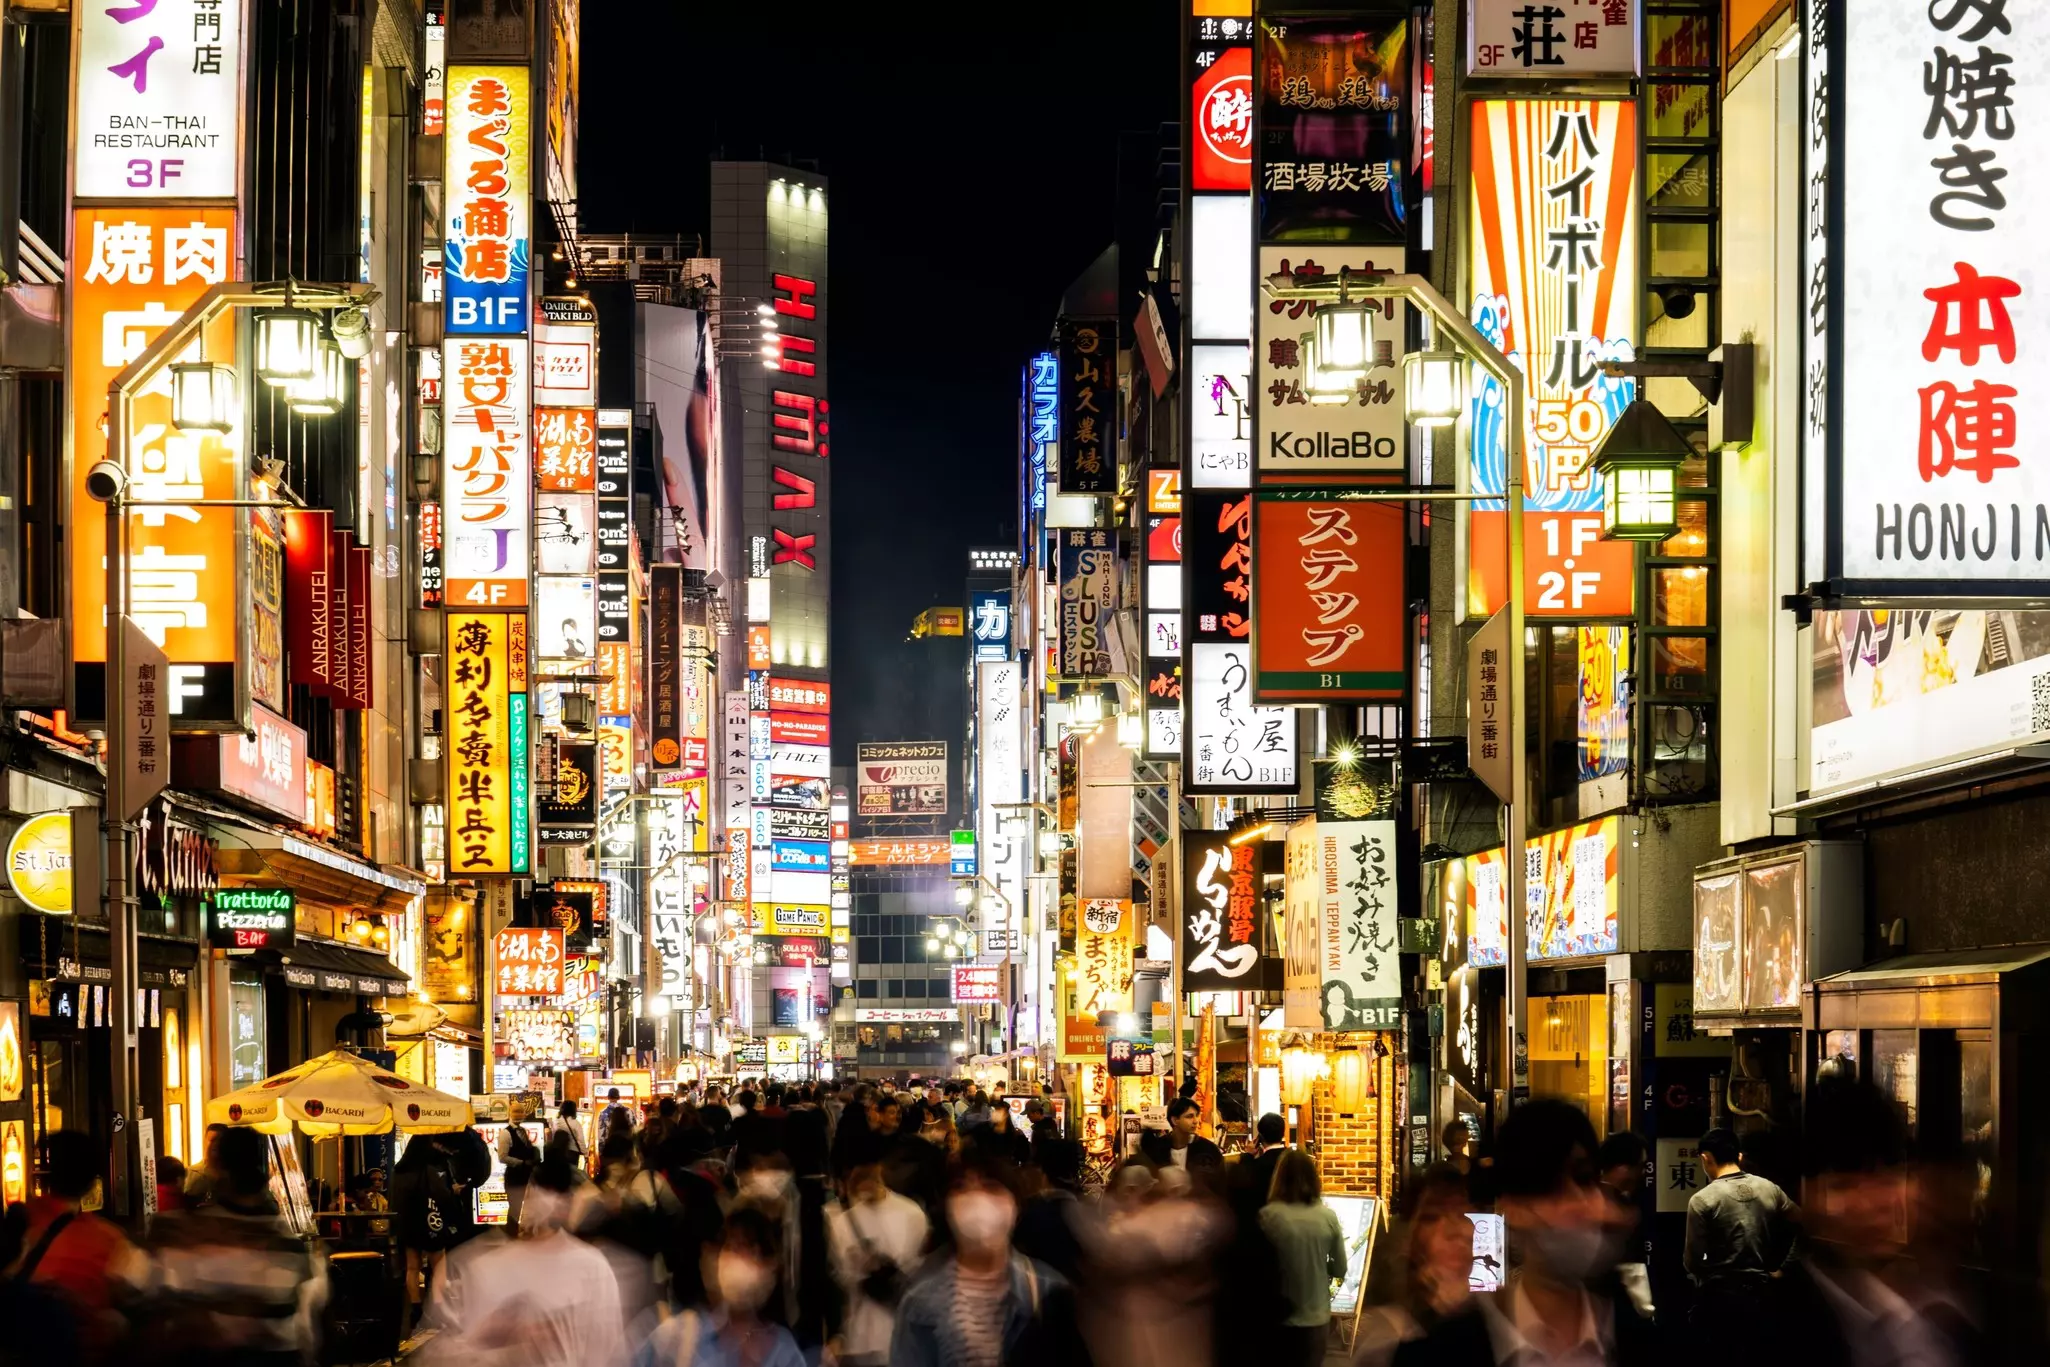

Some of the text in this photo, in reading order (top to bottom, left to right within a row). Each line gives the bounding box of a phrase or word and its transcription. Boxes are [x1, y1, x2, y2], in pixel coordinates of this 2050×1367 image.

[1269, 26, 1288, 39] 2F
[1195, 51, 1215, 67] 4F
[1478, 45, 1505, 66] 3F
[109, 115, 207, 129] BAN-THAI
[94, 134, 219, 148] RESTAURANT
[126, 159, 185, 188] 3F
[463, 78, 511, 281] まぐろ商店
[1264, 161, 1393, 192] 酒場牧場
[84, 221, 228, 285] 焼肉
[1544, 113, 1601, 390] ハイボール
[452, 297, 520, 326] B1F
[544, 302, 582, 312] DAIICHI
[572, 311, 593, 321] BLD
[1917, 261, 2023, 484] 本陣
[1268, 378, 1396, 407] サムサル
[452, 343, 522, 523] 熟女キャバクラ
[538, 412, 593, 447] 湖南
[771, 272, 830, 571] HUMAX
[1074, 360, 1101, 477] 山久農場
[1535, 399, 1604, 444] 50
[1270, 430, 1396, 459] KollaBo
[1546, 444, 1591, 492] 円
[1078, 481, 1099, 490] 5F
[1154, 502, 1180, 510] ENTERT
[1069, 530, 1107, 547] 麻雀
[1541, 518, 1601, 556] 1F
[465, 581, 507, 604] 4F
[1101, 552, 1111, 608] MAH-JONG
[1298, 506, 1365, 668] ステップ
[1536, 571, 1601, 609] 2F
[311, 571, 328, 678] ANRAKUTEI
[332, 588, 348, 692] ANRAKUTEI
[1066, 603, 1078, 673] エスラッシュ
[352, 604, 367, 702] ANRAKUTEI
[510, 621, 525, 683] 炭火串焼
[599, 645, 615, 713] リフッシュ
[1320, 673, 1342, 689] B1
[770, 686, 827, 706] 全店営業中
[1479, 648, 1498, 760] 劇場通り一番街
[137, 663, 156, 773] 劇場通り一番街
[1212, 651, 1253, 783] うまいもん
[761, 719, 769, 754] カラオケ
[861, 746, 944, 758] コミック&ネットカフェ
[771, 751, 826, 764] FACE
[1196, 734, 1215, 783] 一番街
[755, 762, 765, 795] GiGO
[1258, 768, 1293, 784] B1F
[540, 829, 590, 841] 第一大滝ビル
[755, 811, 765, 843] GiGO
[887, 853, 932, 863] ハンバーグ
[214, 891, 291, 910] Trattoria
[1157, 861, 1168, 919] 劇場通り一番街
[1228, 845, 1255, 943] 東京豚骨
[1323, 836, 1341, 972] HIROSHIMA TEPPANYAKI
[217, 913, 286, 930] Pizzeria
[775, 907, 818, 924] GAME PANIC
[1086, 906, 1119, 923] 新宿
[1345, 834, 1395, 983] お好み焼き
[235, 930, 266, 946] Bar
[1097, 923, 1109, 933] の
[499, 932, 561, 964] 湖南
[1084, 935, 1109, 1012] まっちゃん
[958, 984, 998, 997] 営業中
[866, 1009, 900, 1021] コーヒー
[1362, 1007, 1399, 1024] B1F
[1069, 1034, 1094, 1043] ONLINE
